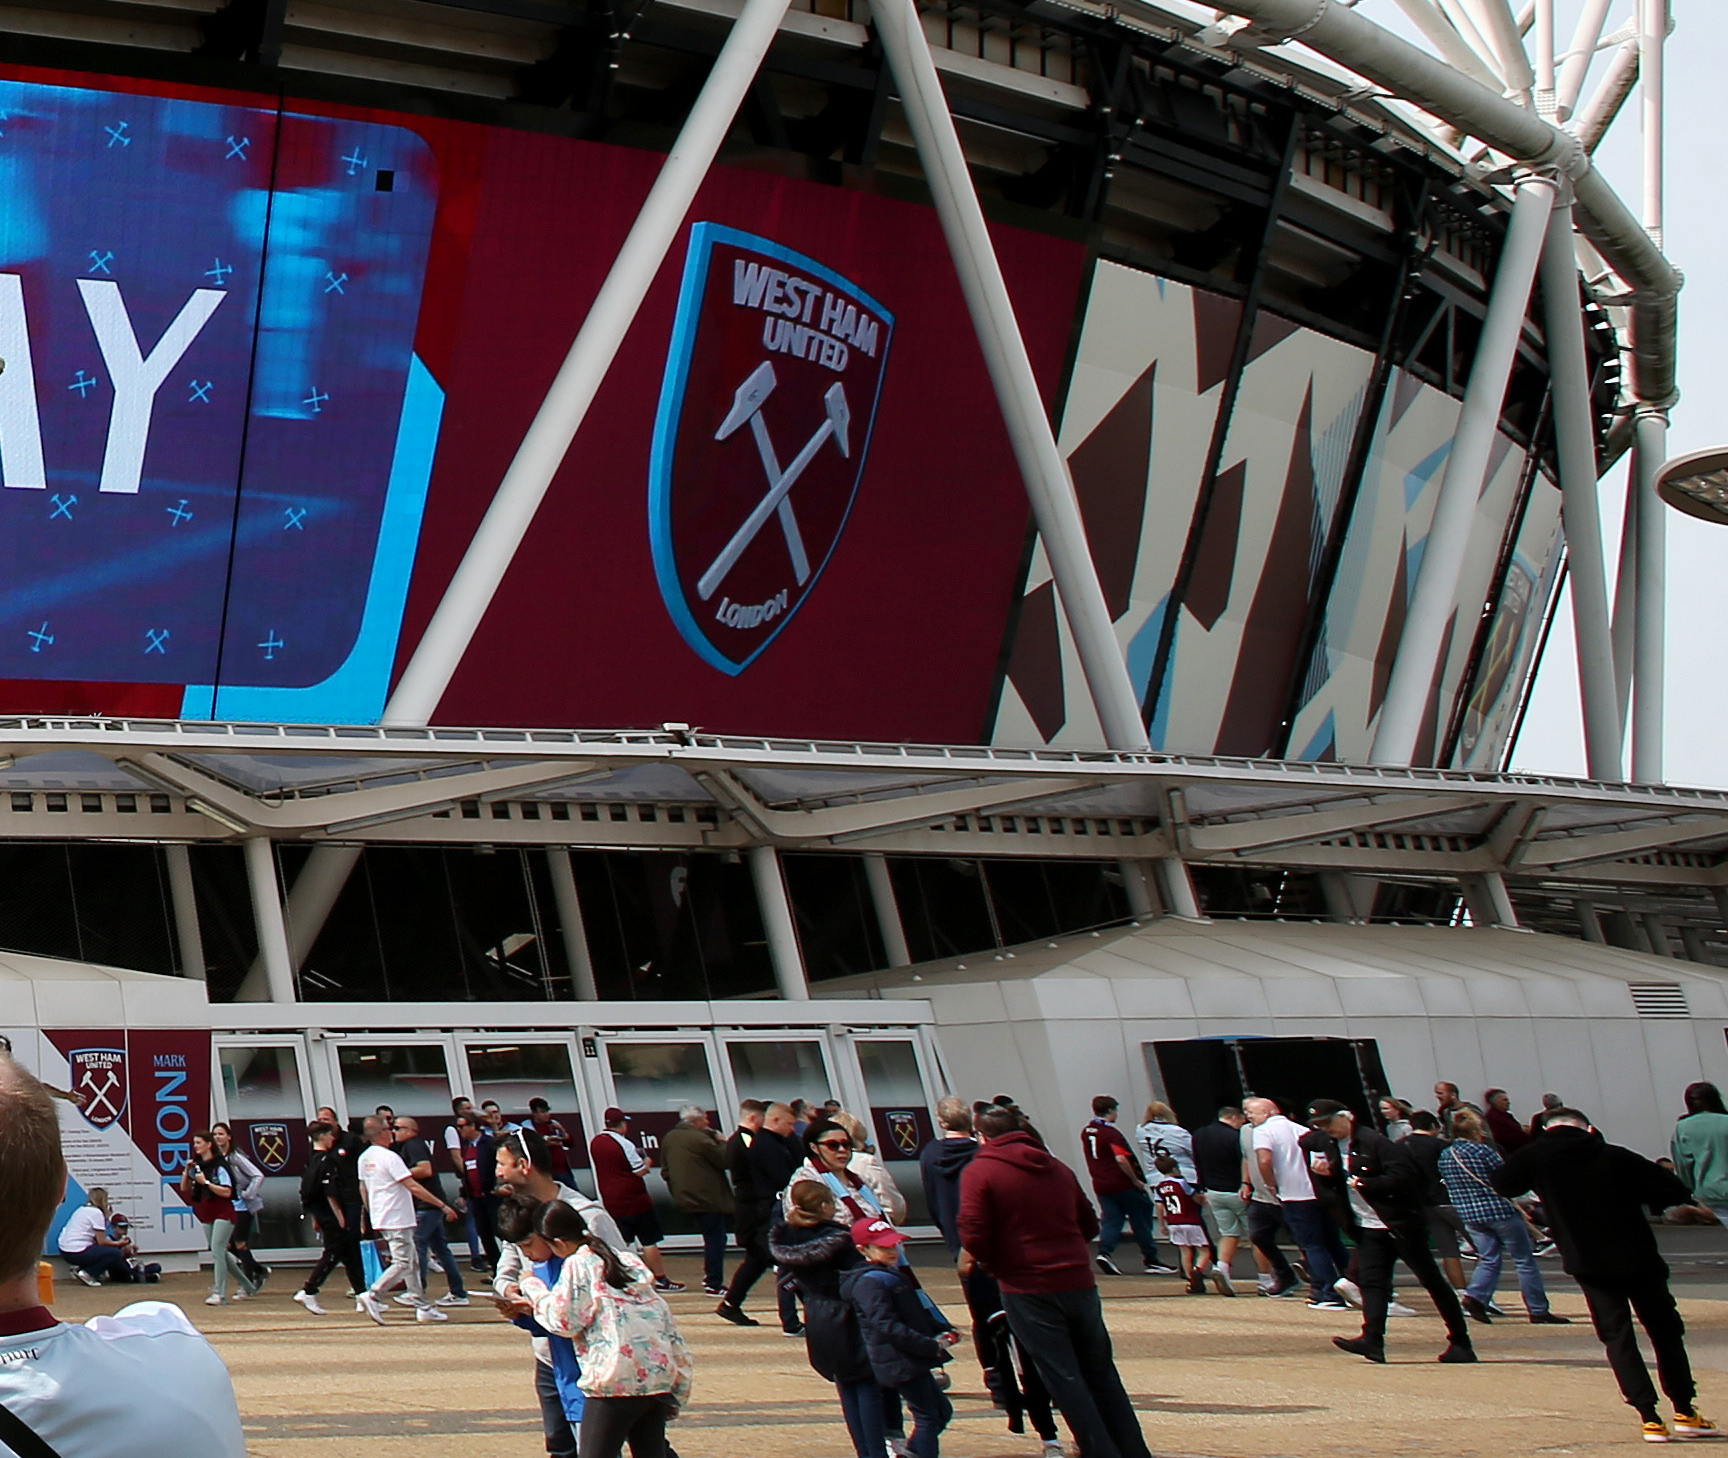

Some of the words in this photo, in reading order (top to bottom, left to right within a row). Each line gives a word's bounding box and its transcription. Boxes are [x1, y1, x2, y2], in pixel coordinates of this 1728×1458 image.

[732, 258, 822, 326] WEST
[820, 292, 880, 358] HAM
[762, 315, 850, 373] UNITED
[715, 588, 790, 631] LONDON
[75, 1053, 99, 1064] WEST
[100, 1053, 122, 1064] HAM
[85, 1061, 113, 1070] UNITED
[153, 1054, 187, 1068] MARK
[153, 1070, 195, 1234] NOBLE
